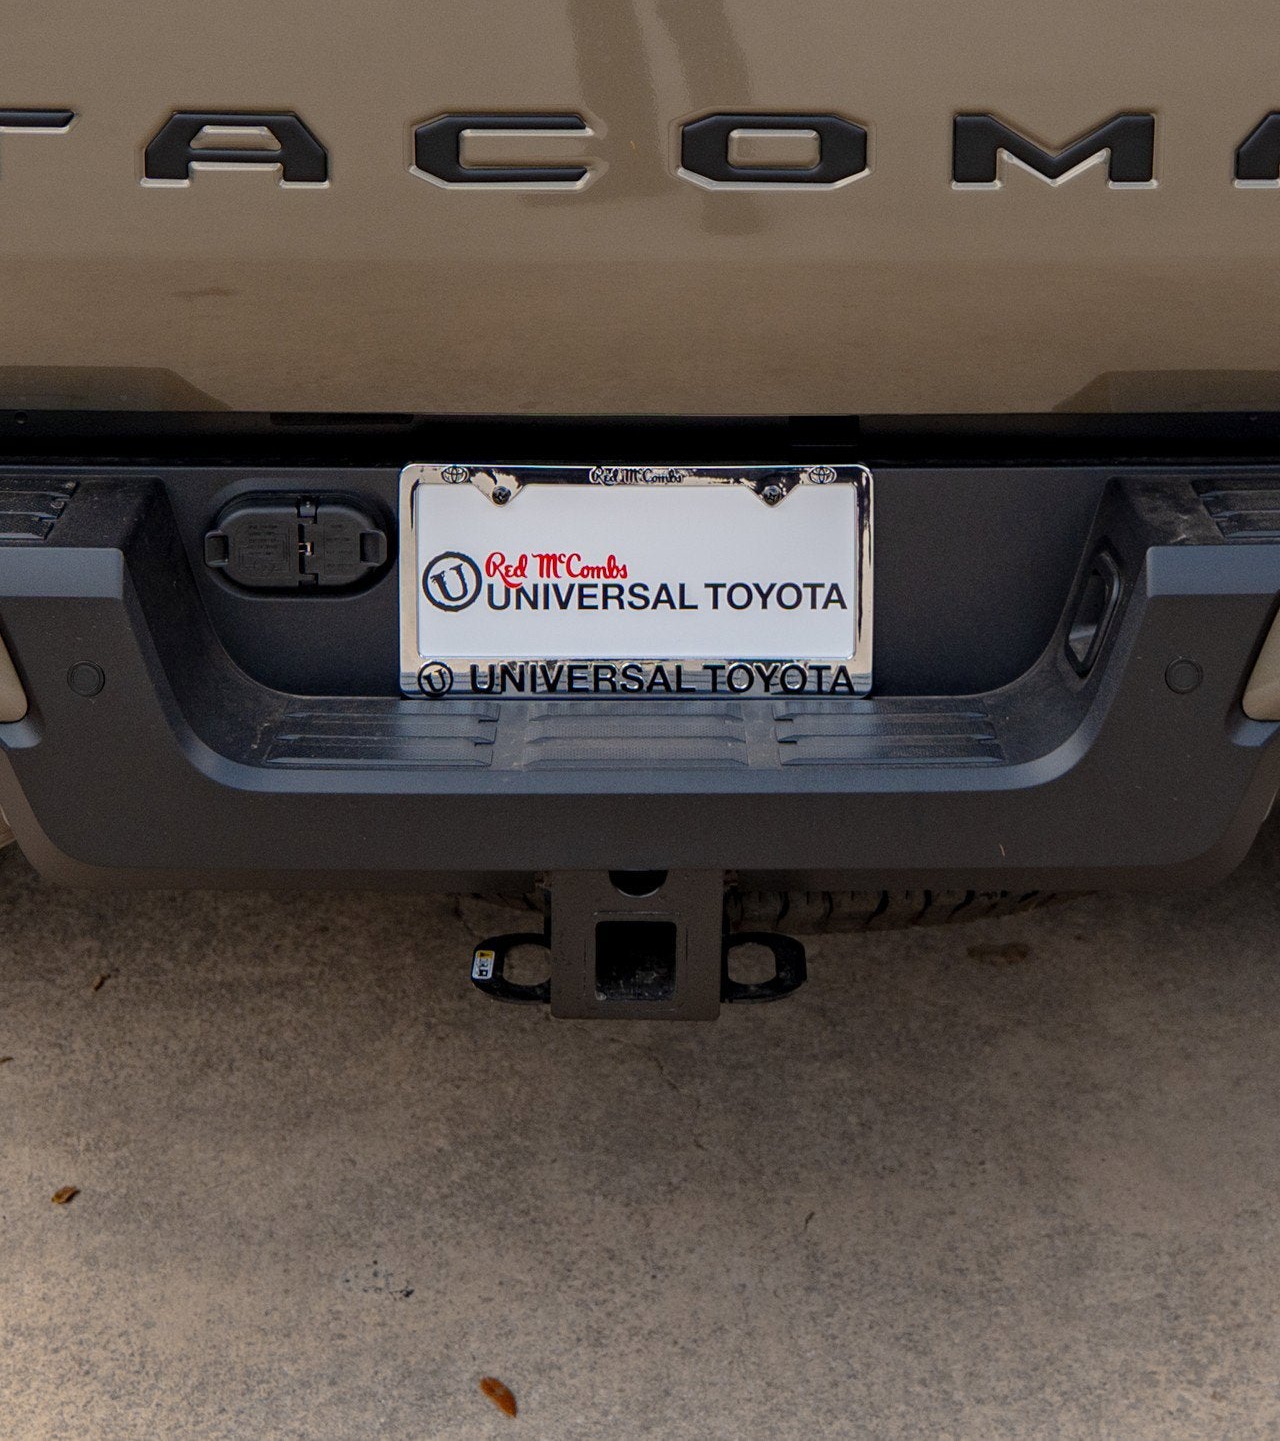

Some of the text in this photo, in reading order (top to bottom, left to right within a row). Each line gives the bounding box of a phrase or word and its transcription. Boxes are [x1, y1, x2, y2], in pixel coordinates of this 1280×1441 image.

[590, 466, 685, 487] Red McCombs
[485, 551, 628, 588] Red McCombs
[486, 582, 848, 610] UNIVERSAL TOYOTA
[470, 663, 696, 695] UNIVERSAL
[703, 664, 855, 695] TOYOTA
